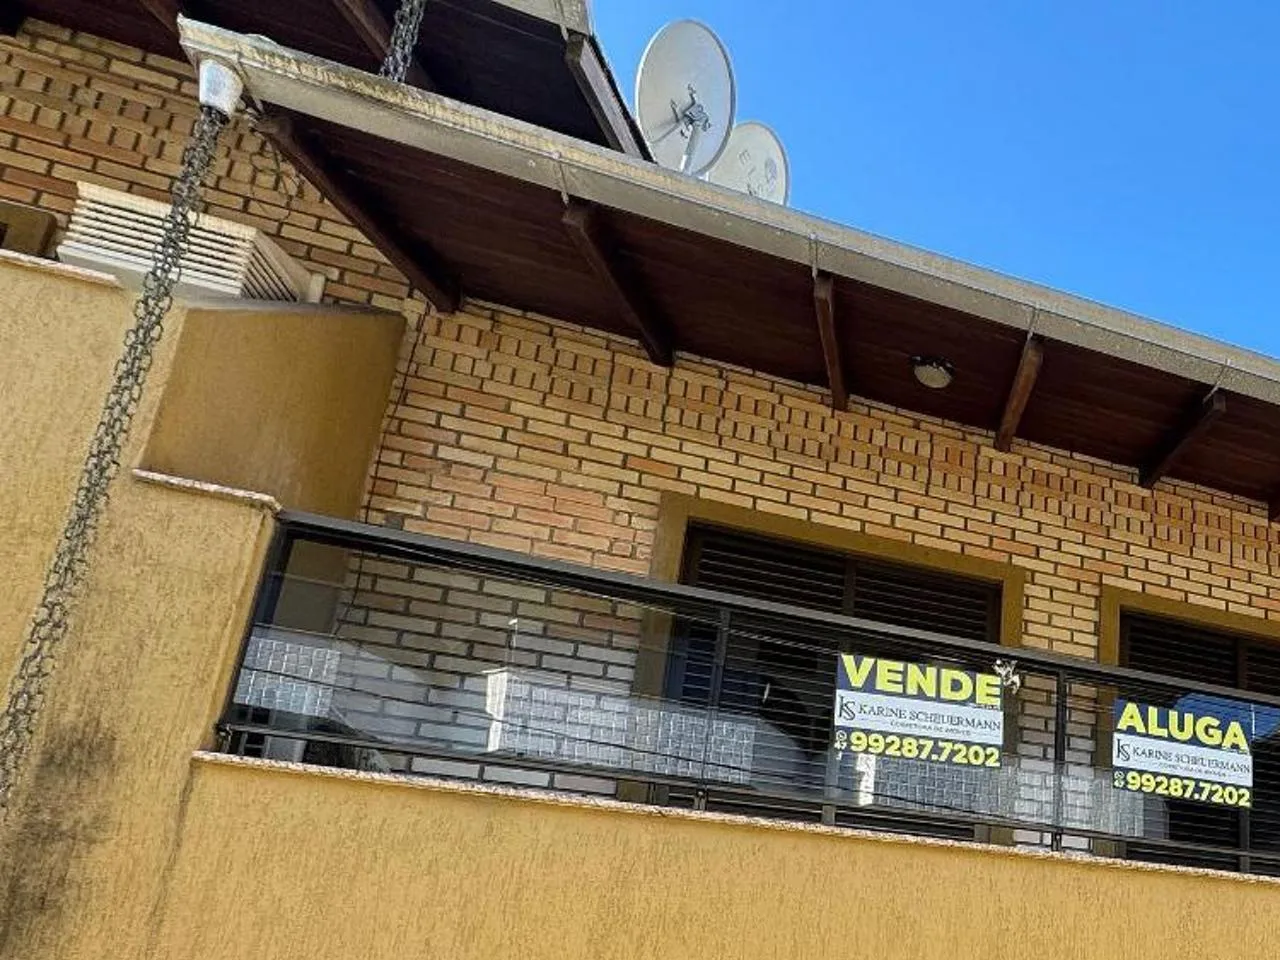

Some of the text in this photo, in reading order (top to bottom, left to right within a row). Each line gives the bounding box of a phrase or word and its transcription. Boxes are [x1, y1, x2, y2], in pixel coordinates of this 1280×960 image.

[841, 653, 1000, 705] VENDE
[858, 703, 907, 720] KARINE
[1116, 702, 1250, 754] ALUGA
[850, 731, 1000, 768] 99287.7202
[1132, 746, 1173, 762] KARINE
[1125, 771, 1251, 808] 99287.7202
